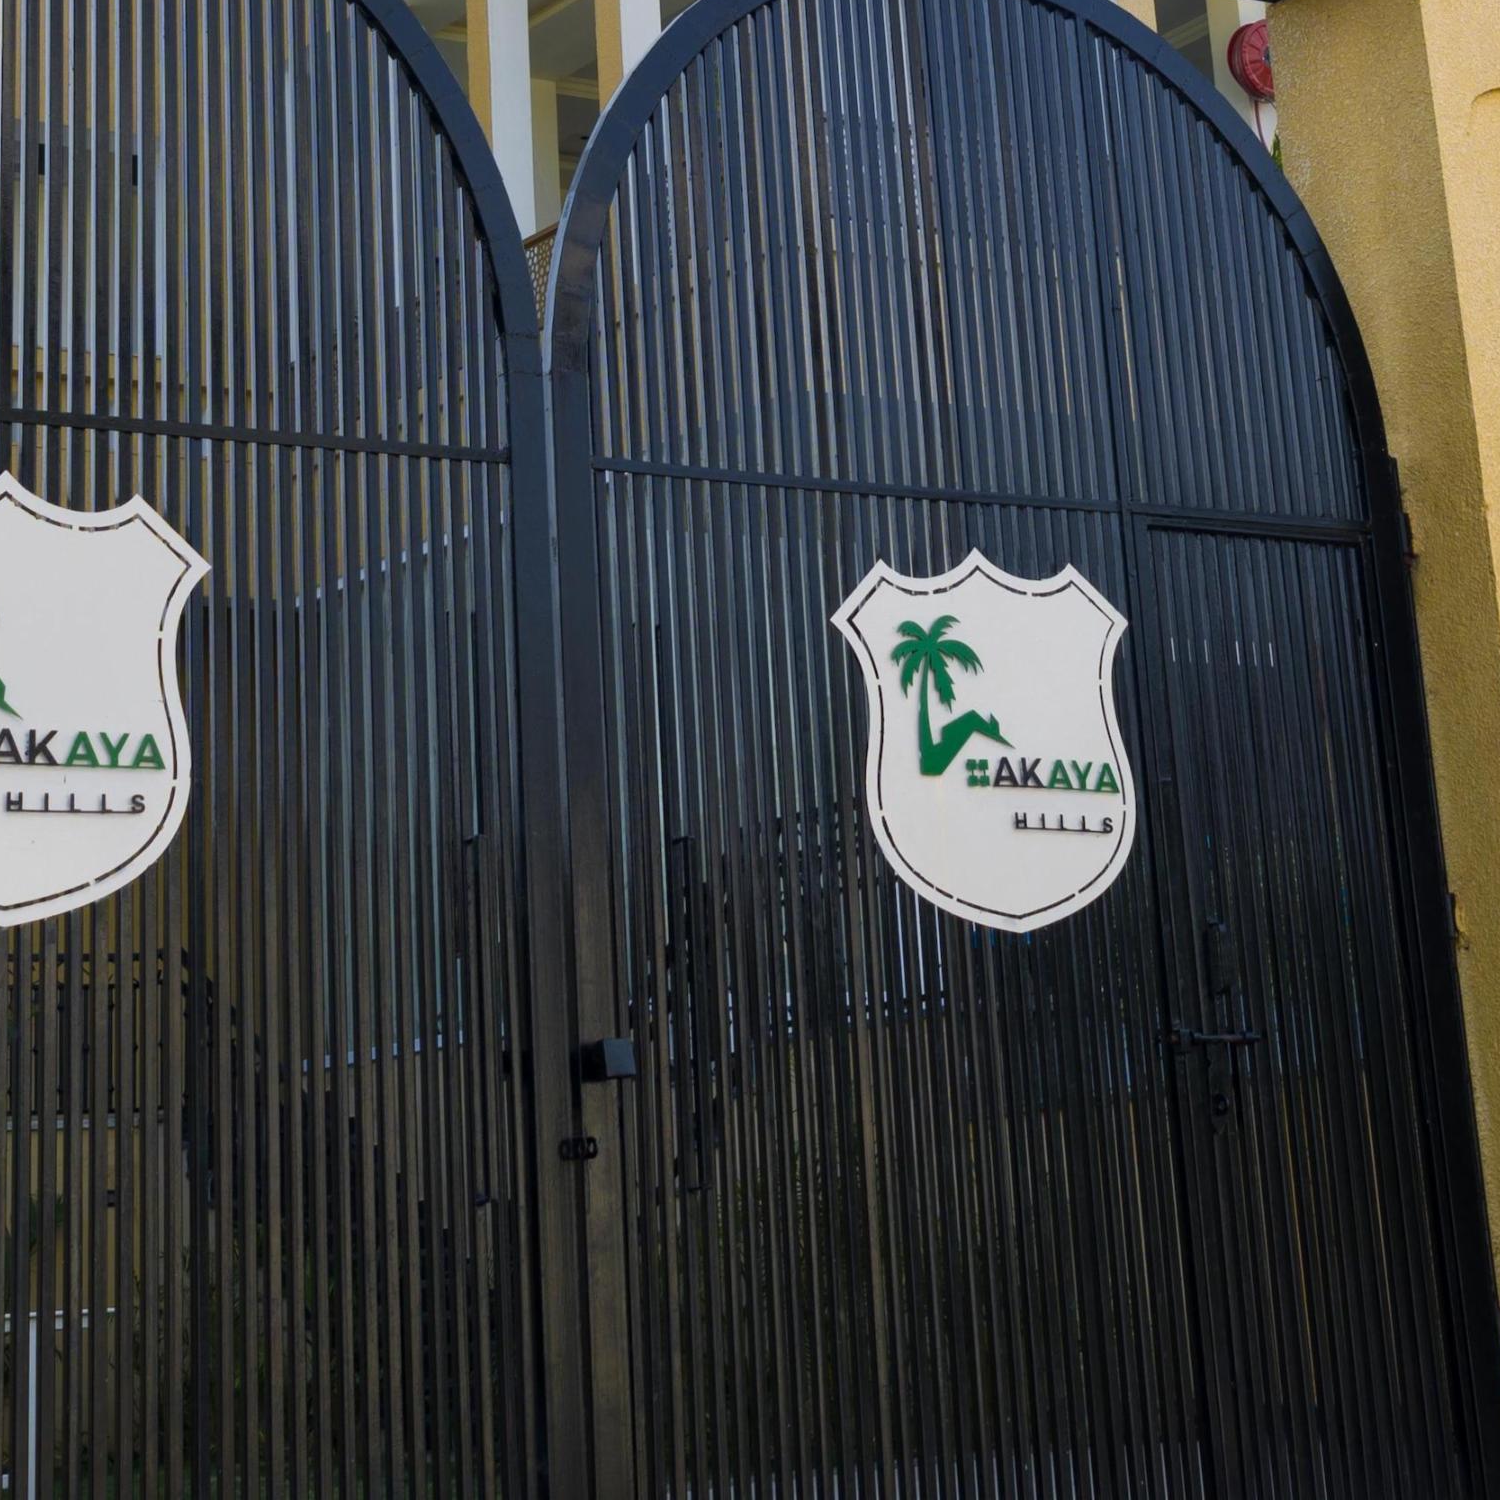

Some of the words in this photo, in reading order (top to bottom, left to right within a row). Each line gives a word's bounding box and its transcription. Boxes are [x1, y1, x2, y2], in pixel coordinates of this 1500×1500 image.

[993, 756, 1120, 793] AKAYA
[6, 791, 146, 814] HILLS
[1014, 811, 1114, 834] HILLS
